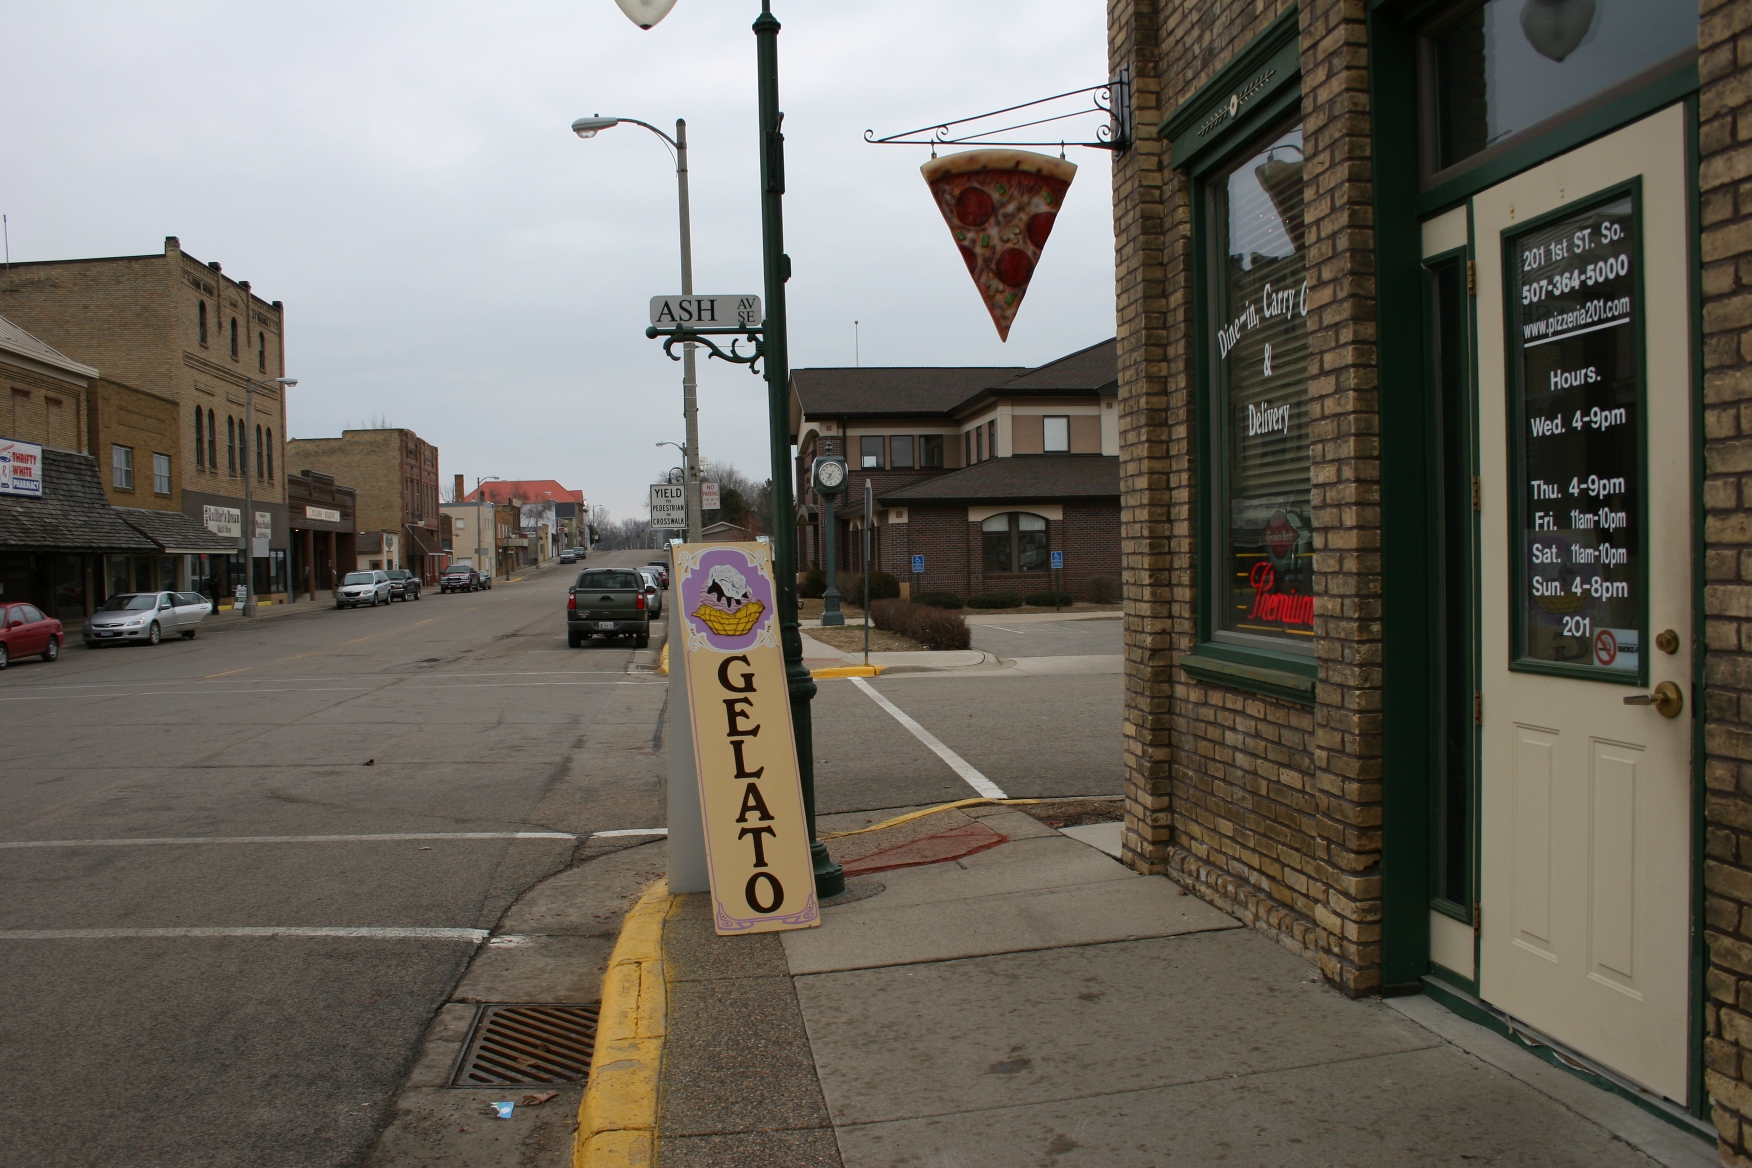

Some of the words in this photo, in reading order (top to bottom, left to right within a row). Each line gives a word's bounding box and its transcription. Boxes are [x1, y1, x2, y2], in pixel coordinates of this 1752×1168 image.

[1523, 246, 1544, 272] 201
[1550, 239, 1568, 262] 1st
[1574, 228, 1595, 254] ST.
[1601, 221, 1625, 244] So.
[1522, 254, 1629, 305] 507-364-5000
[656, 299, 718, 322] ASH
[737, 298, 756, 309] AV
[737, 311, 755, 322] SE
[1217, 301, 1260, 360] Dine-in,
[1263, 282, 1295, 320] Carry
[1523, 297, 1630, 339] www.pizzeria201.com
[1263, 343, 1272, 377] &
[1550, 366, 1601, 391] Hours.
[1248, 401, 1290, 436] Delivery
[1531, 413, 1566, 437] Wed.
[1572, 406, 1626, 431] 4-9pm
[12, 451, 37, 465] THRIFTY
[12, 465, 32, 477] WHITE
[13, 478, 40, 490] PHARMACY
[654, 488, 682, 498] YIELD
[1531, 480, 1562, 499] Thu.
[1568, 474, 1625, 499] 4-9pm
[653, 504, 684, 512] PEDESTRIAN
[1535, 511, 1557, 531] Fri.
[1570, 507, 1626, 532] 11am-10pm
[653, 517, 684, 525] CROSSWALK
[1266, 530, 1281, 542] Grain
[1282, 530, 1293, 541] Belt
[1532, 543, 1561, 563] Sat.
[1571, 542, 1627, 568] 11am-10pm
[1532, 576, 1565, 597] Sun.
[1571, 576, 1628, 601] 4-8pm
[1562, 615, 1590, 637] 201
[718, 654, 785, 914] GELATO
